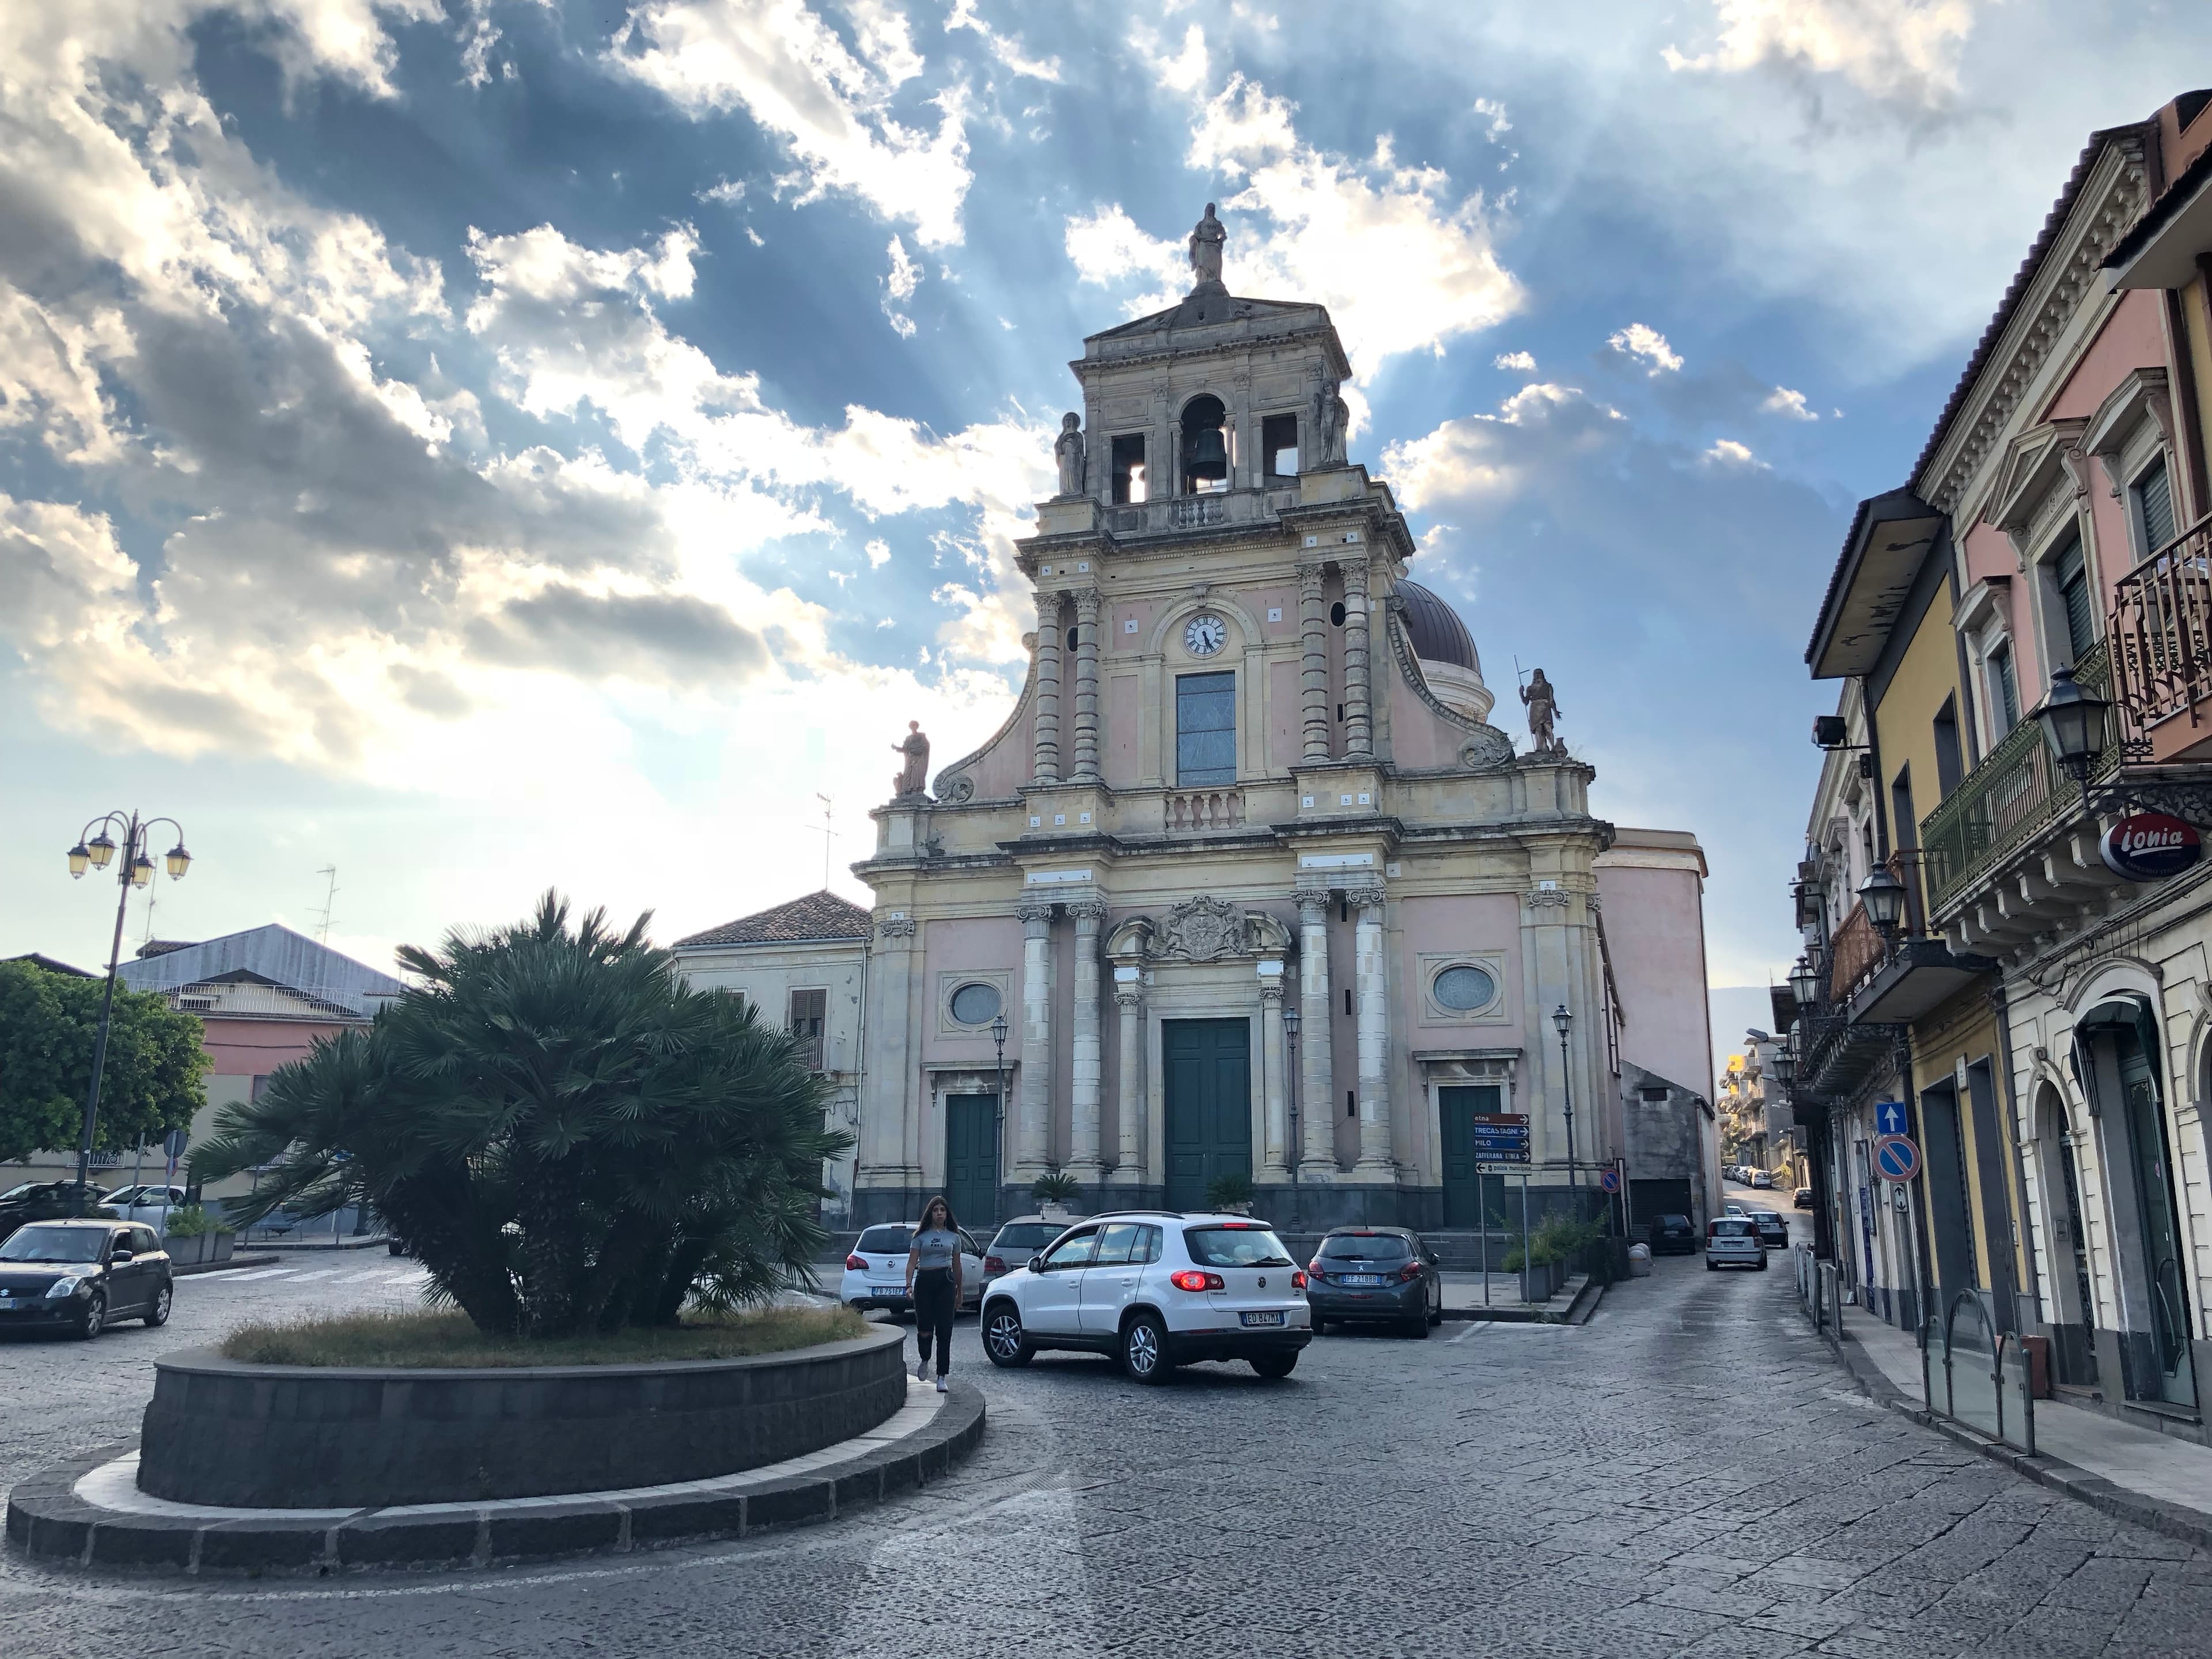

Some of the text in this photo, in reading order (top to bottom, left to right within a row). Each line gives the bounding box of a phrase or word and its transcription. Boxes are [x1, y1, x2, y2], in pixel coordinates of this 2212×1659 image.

[2121, 825, 2183, 852] ionia
[1247, 1313, 1279, 1323] ED 847MX
